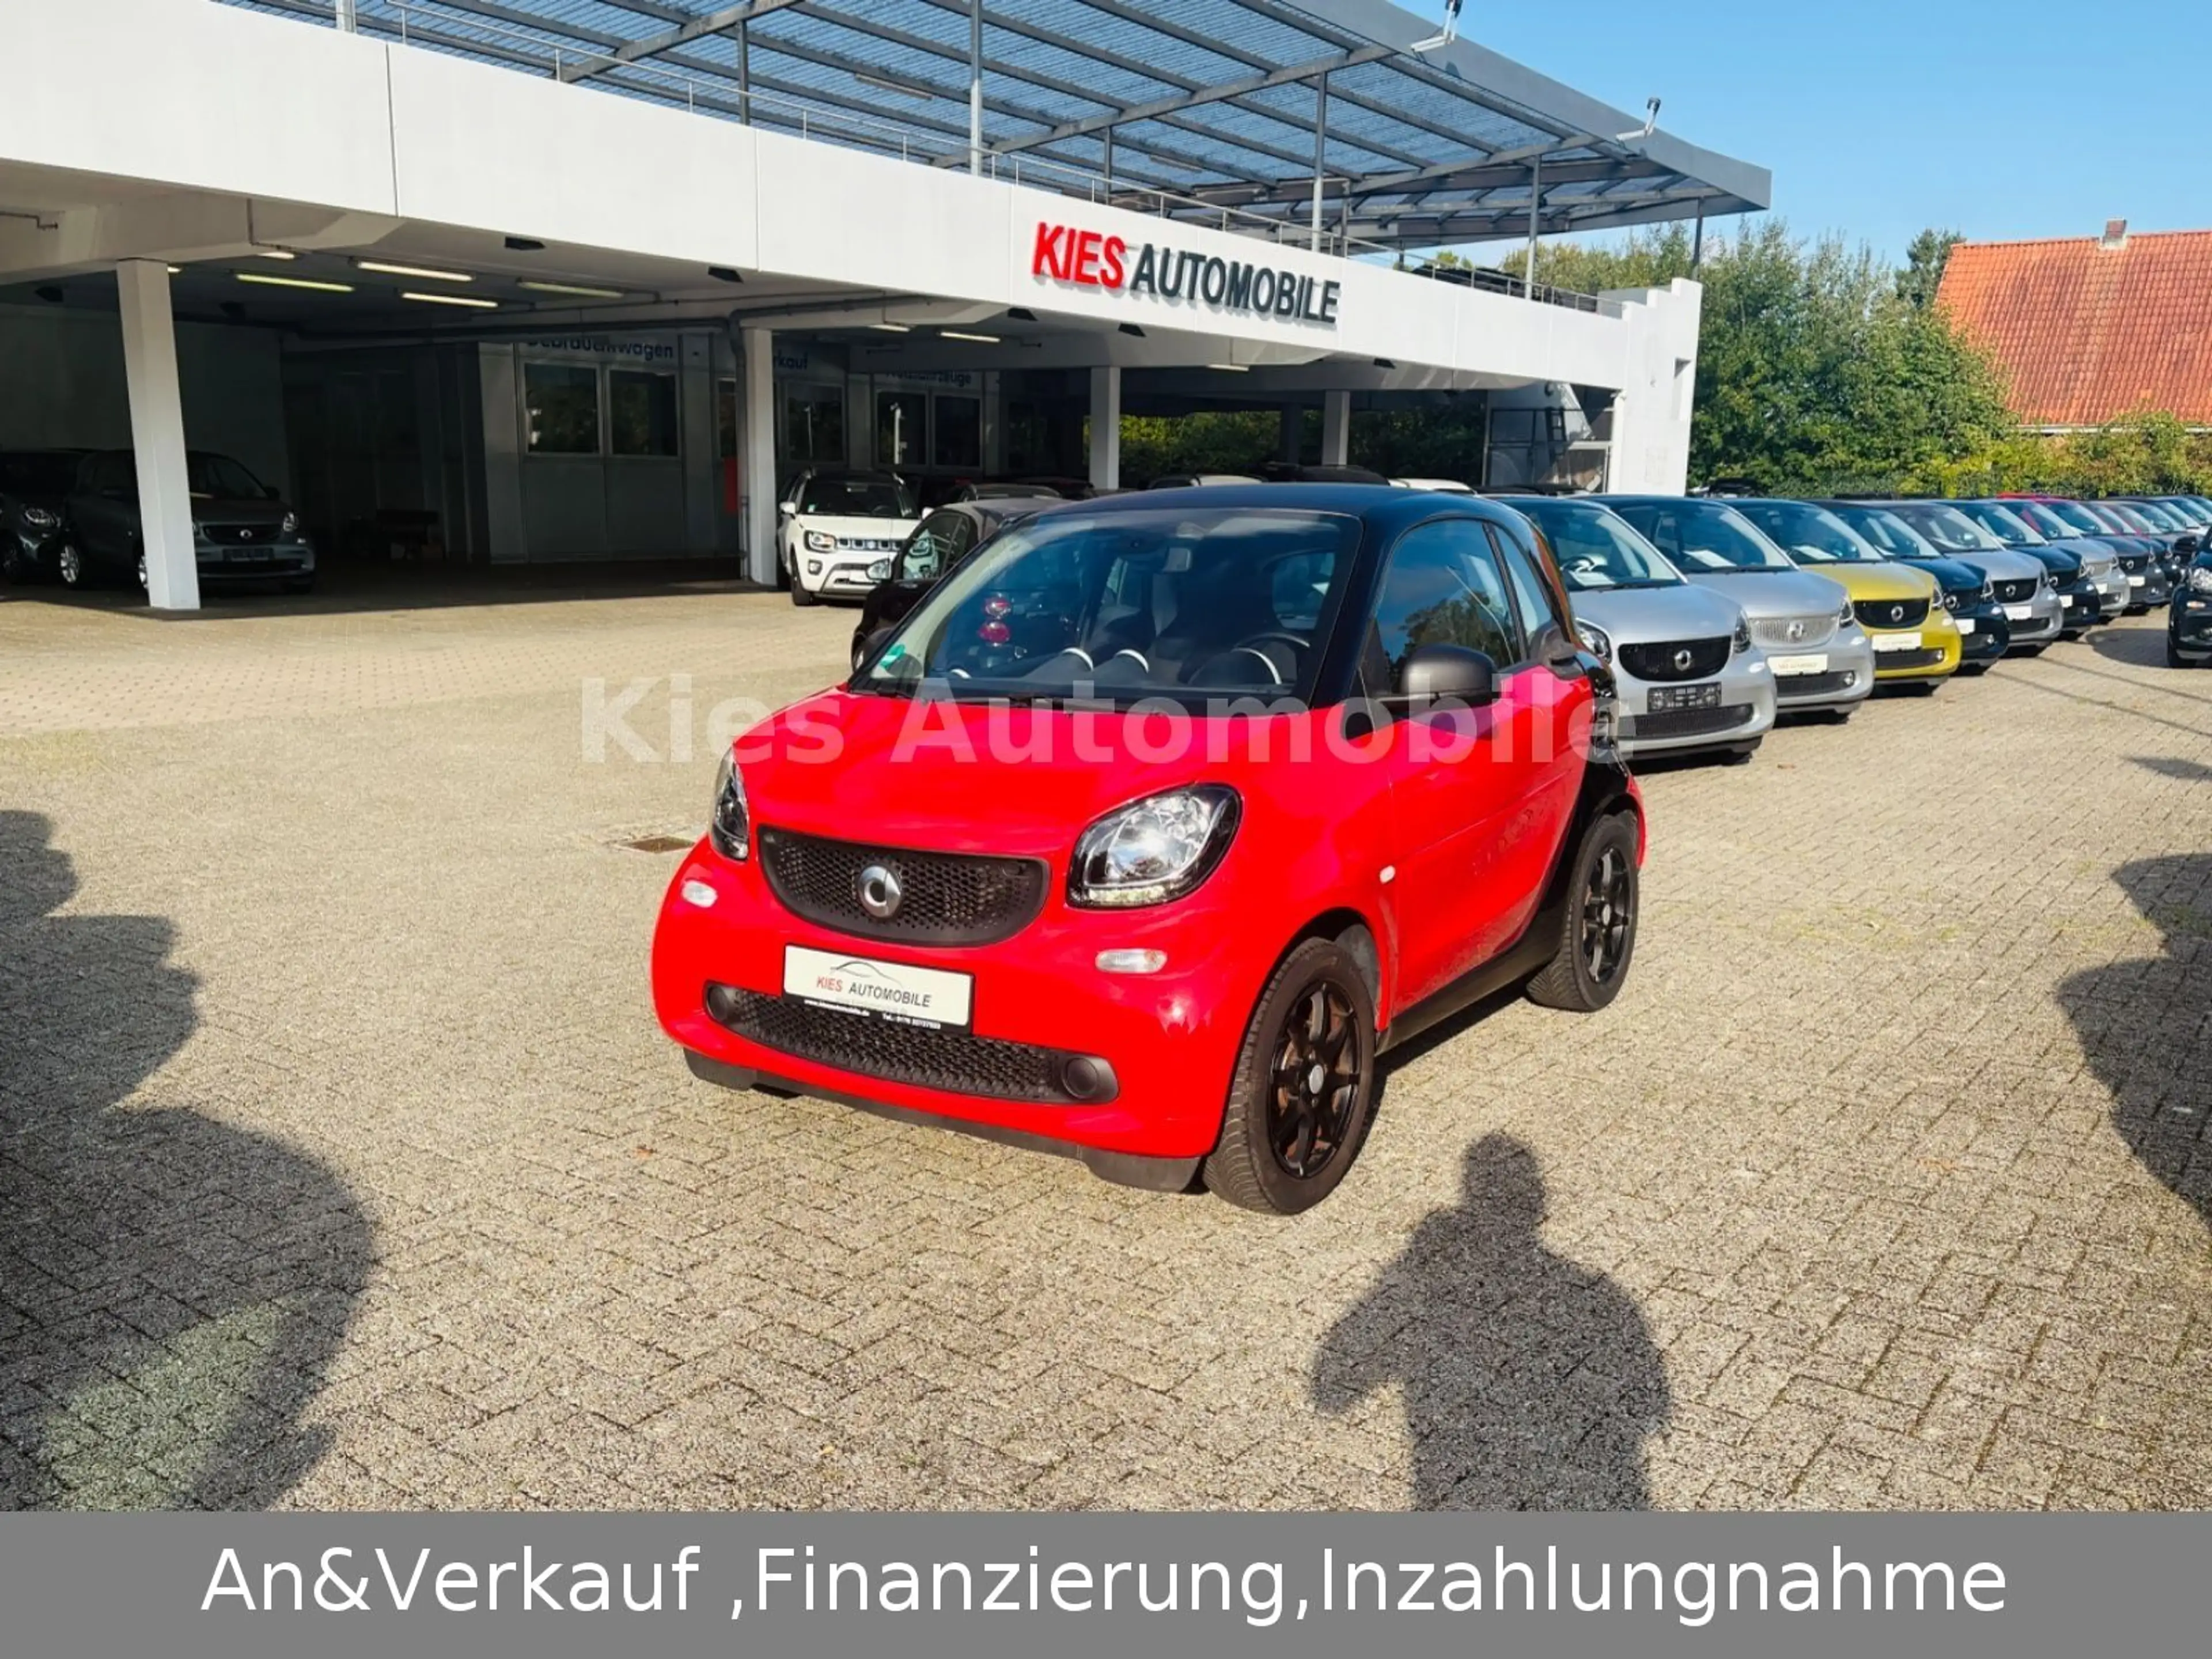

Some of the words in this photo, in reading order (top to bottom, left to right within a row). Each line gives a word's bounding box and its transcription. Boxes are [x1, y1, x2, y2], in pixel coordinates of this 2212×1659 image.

[1032, 221, 1126, 289] KIES
[1130, 243, 1341, 323] AUTOMOBILE
[816, 976, 843, 993] KIES
[849, 982, 932, 1007] AUTOMOBILE
